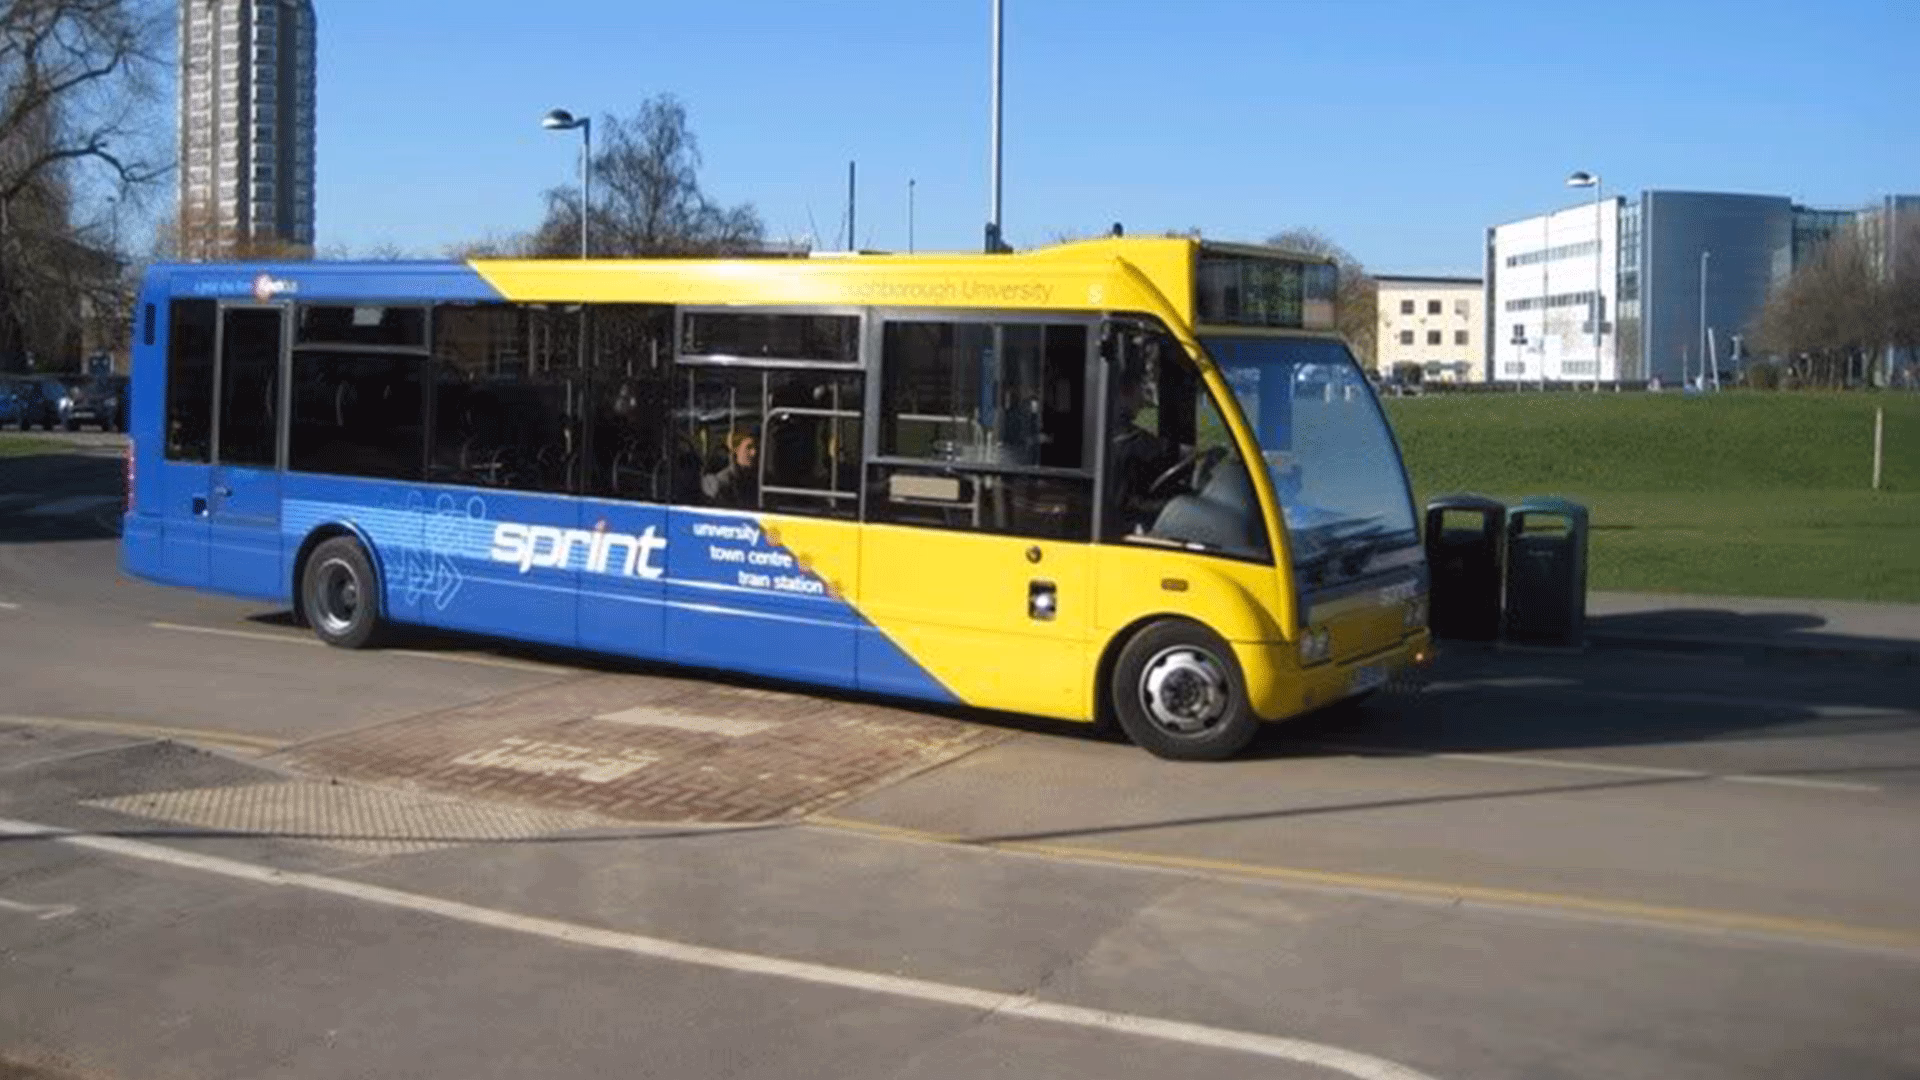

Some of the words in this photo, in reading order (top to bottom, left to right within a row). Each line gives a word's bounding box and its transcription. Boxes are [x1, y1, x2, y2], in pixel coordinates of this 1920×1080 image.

[961, 281, 1055, 304] University
[692, 521, 760, 546] university
[491, 519, 667, 579] sprint
[708, 544, 746, 563] town
[748, 550, 793, 568] centre
[737, 570, 771, 588] train
[773, 575, 825, 594] station
